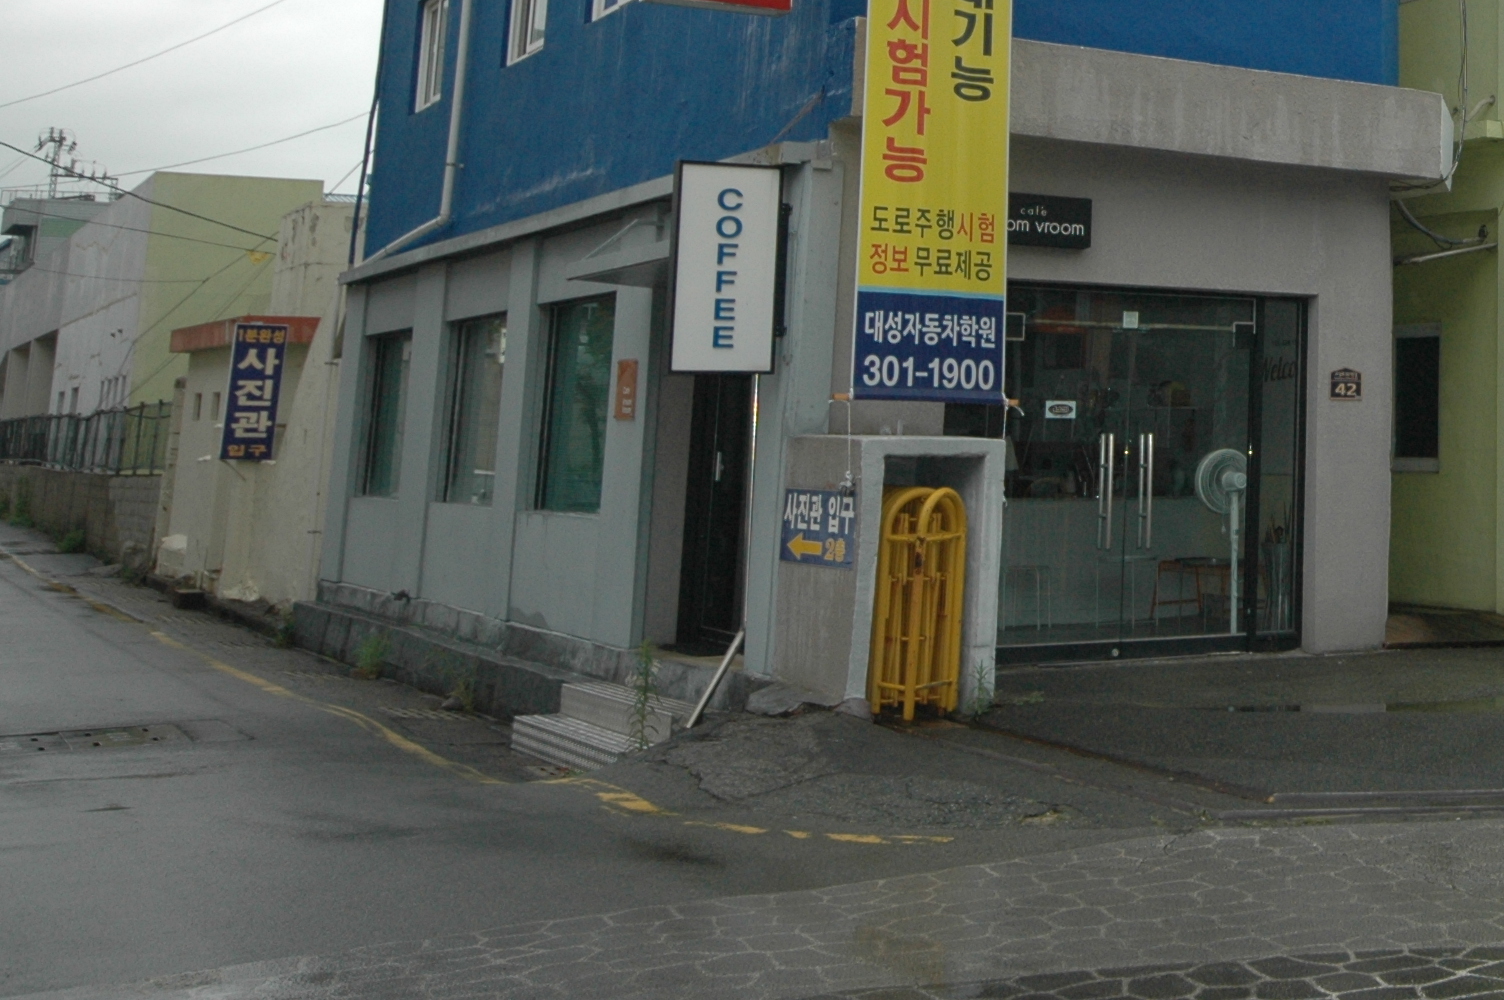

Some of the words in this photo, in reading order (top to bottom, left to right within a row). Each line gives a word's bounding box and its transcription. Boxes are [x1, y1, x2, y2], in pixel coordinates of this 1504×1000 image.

[1035, 220, 1085, 236] vroom
[712, 187, 744, 349] COFFEE
[865, 310, 996, 350] 대성자동차학원
[863, 354, 995, 391] 301-1900
[1335, 382, 1357, 396] 42
[230, 347, 280, 439] 사진관
[227, 444, 267, 457] 입구
[784, 492, 822, 531] 사진관
